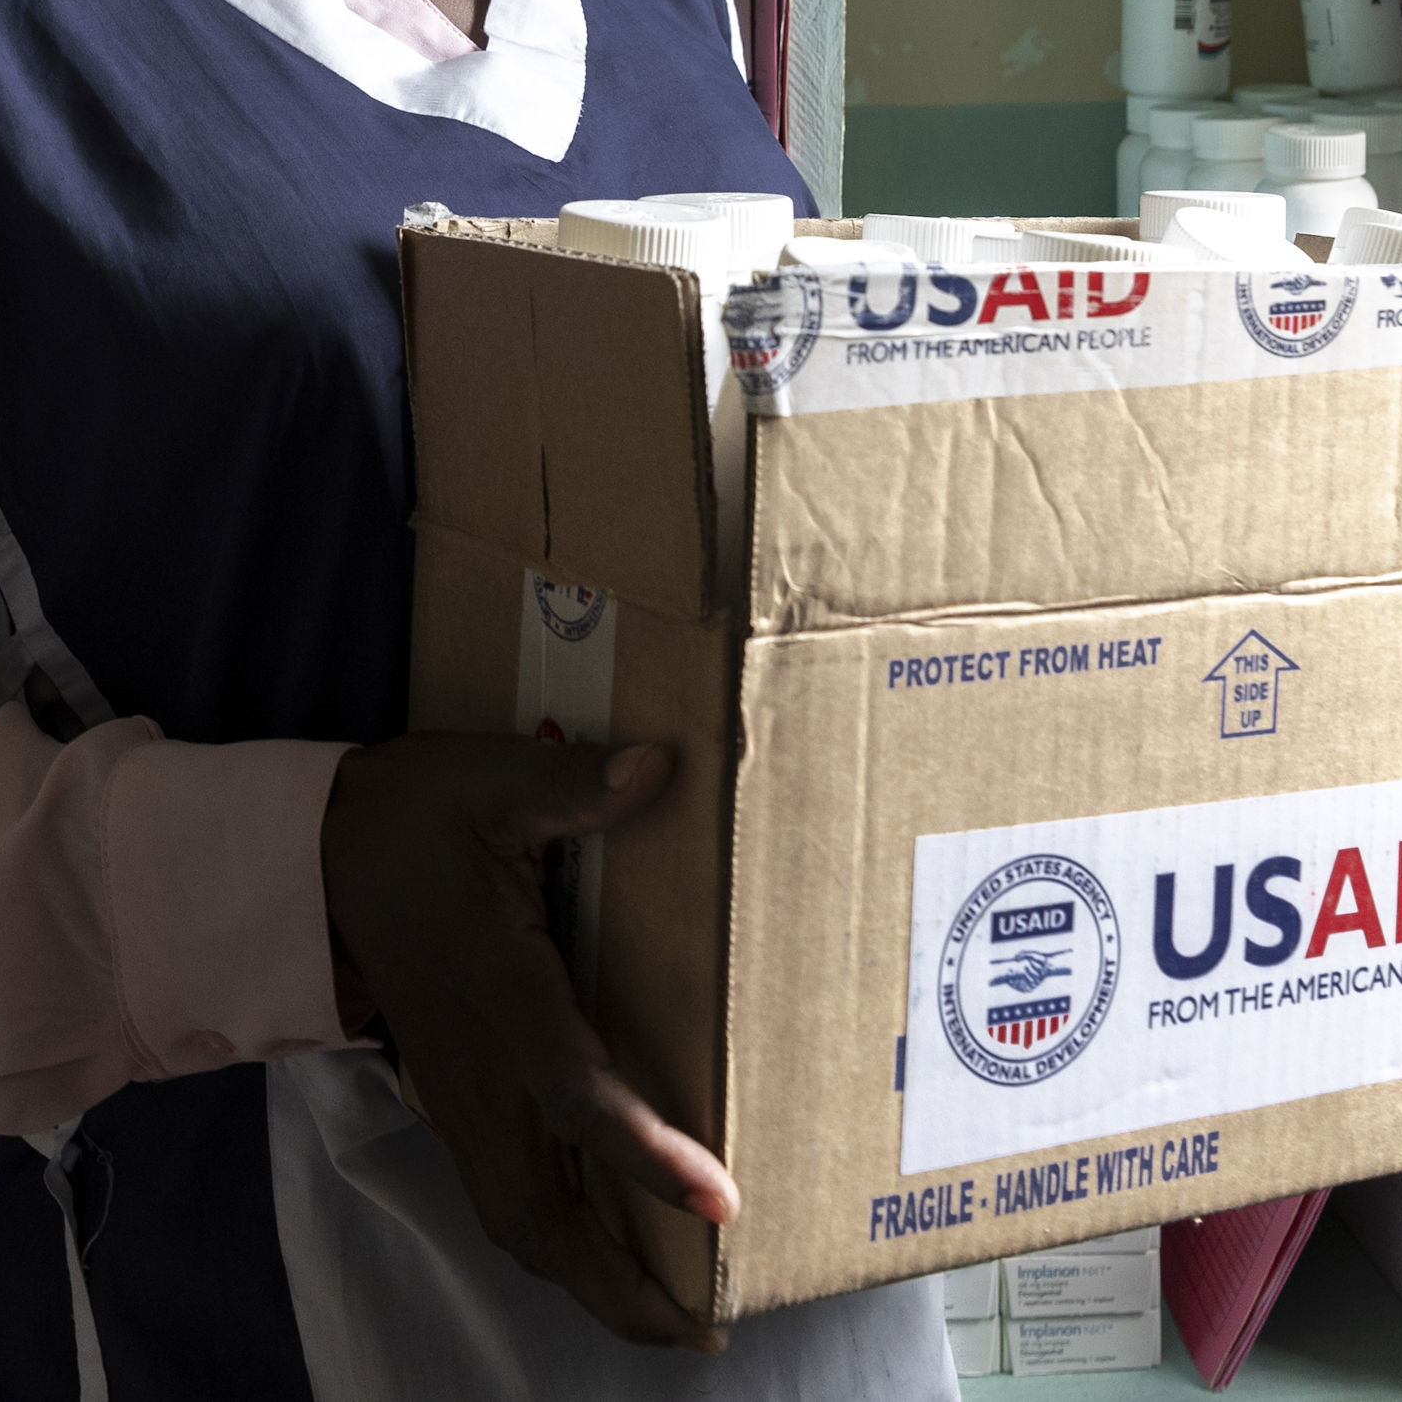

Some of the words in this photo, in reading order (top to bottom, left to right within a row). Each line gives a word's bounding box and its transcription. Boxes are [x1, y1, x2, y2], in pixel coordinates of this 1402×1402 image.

[846, 262, 1151, 331] USAID
[846, 340, 907, 366] FROM
[911, 338, 956, 360] THE
[957, 332, 1072, 357] AMERICAN
[1077, 326, 1152, 351] PEOPLE
[888, 650, 1012, 688] PROTECT
[1018, 641, 1091, 676] FROM
[1097, 637, 1163, 670] HEAT
[1233, 652, 1270, 675] THIS
[1233, 680, 1270, 702] SIDE
[1240, 709, 1262, 730] UP
[952, 878, 1003, 944] UNITED
[1004, 860, 1062, 885] STATES
[1062, 865, 1113, 922] AGENCY
[998, 909, 1067, 937] USAID
[942, 983, 1032, 1081] INTERNATIONAL
[1035, 959, 1116, 1077] DEVELOPMENT
[1148, 991, 1220, 1029] FROM
[1224, 982, 1274, 1016] THE
[870, 1180, 975, 1242] FRAGILE
[994, 1157, 1090, 1217] HANDLE
[1096, 1144, 1154, 1196] WITH
[1161, 1131, 1220, 1183] CARE
[1017, 1264, 1080, 1280] Implanon
[1019, 1324, 1082, 1339] Implanon
